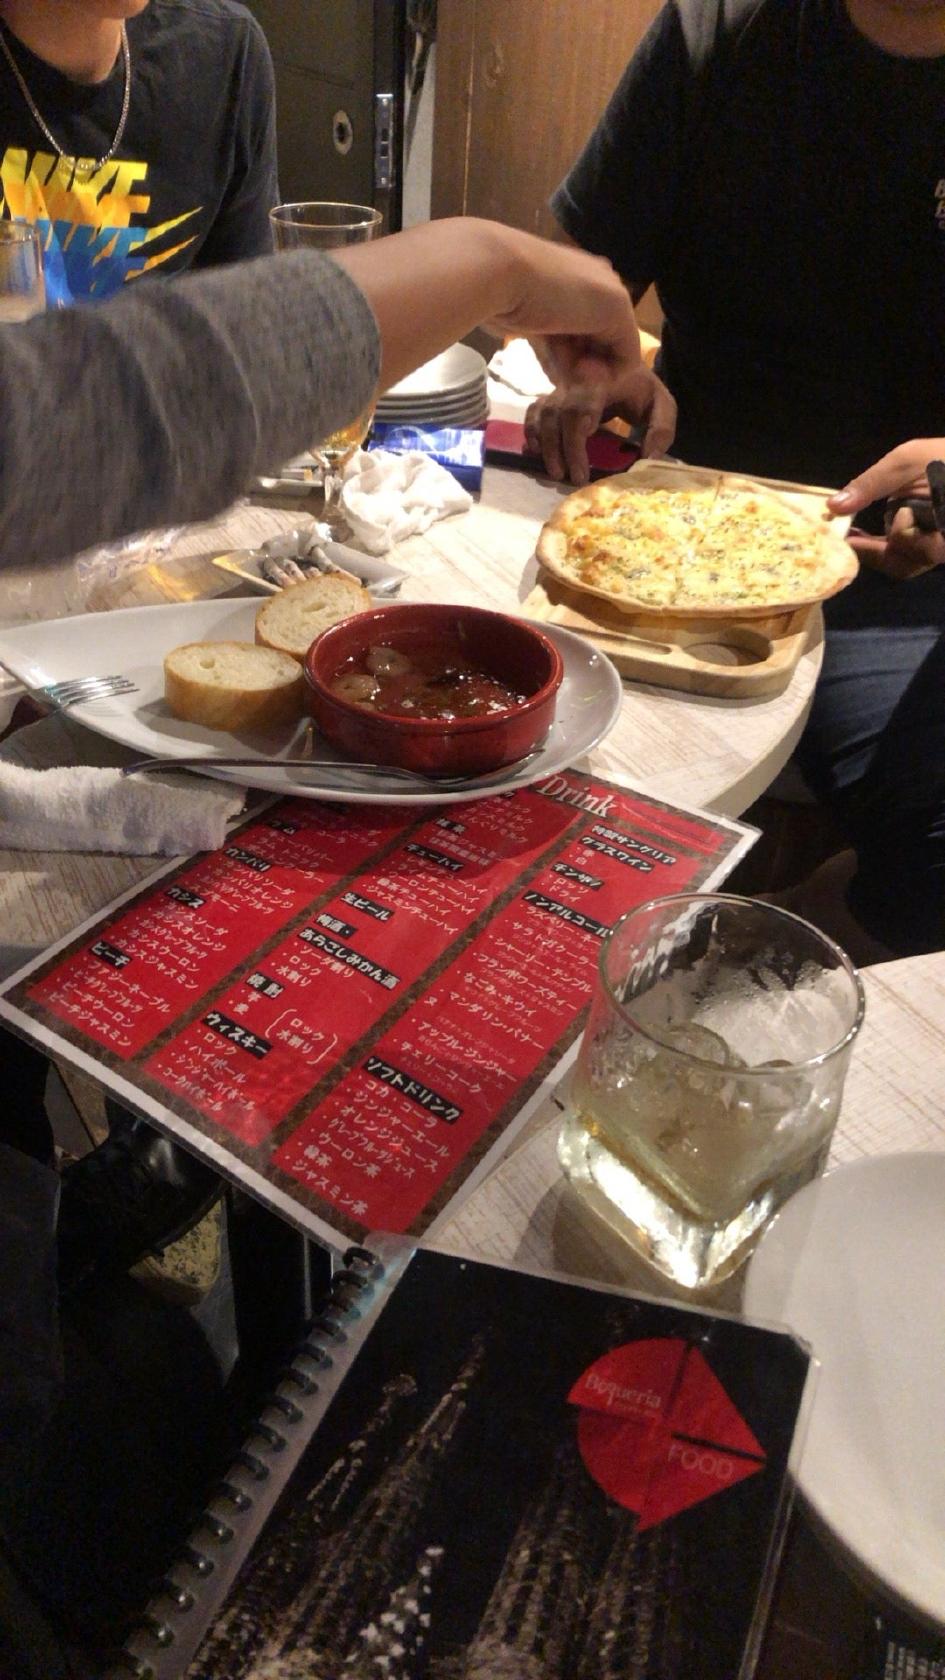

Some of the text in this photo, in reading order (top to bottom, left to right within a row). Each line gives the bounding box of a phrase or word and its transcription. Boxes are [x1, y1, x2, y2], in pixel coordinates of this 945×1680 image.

[538, 774, 619, 819] Drink
[406, 843, 464, 872] チューハイ
[581, 836, 652, 871] グラスワイン
[591, 824, 677, 865] 特製サングリア
[165, 887, 204, 909] カシス
[343, 892, 390, 921] 生ビール
[525, 893, 608, 937] ノンアルコール
[128, 928, 201, 973] カシスウーロン
[153, 910, 227, 951] カシスオレンジ
[116, 938, 199, 990] カシスジャスミン
[289, 955, 322, 976] ロック
[300, 928, 400, 989] あらごしみかん酒
[300, 945, 355, 978] ソーダ割り
[204, 1032, 237, 1055] ロック
[206, 1012, 268, 1056] ウィスキー
[189, 1045, 247, 1084] ハイボール
[366, 1057, 460, 1120] ソフトドリンク
[366, 1080, 438, 1128] コカ・コーラ
[341, 1105, 439, 1173] オレンジジュース
[353, 1091, 450, 1158] ジンジャーエール
[318, 1132, 382, 1178] ウーロン茶
[292, 1160, 369, 1216] ジャスミン茶
[585, 1372, 662, 1408] Boqueria
[667, 1444, 733, 1480] FOOD
